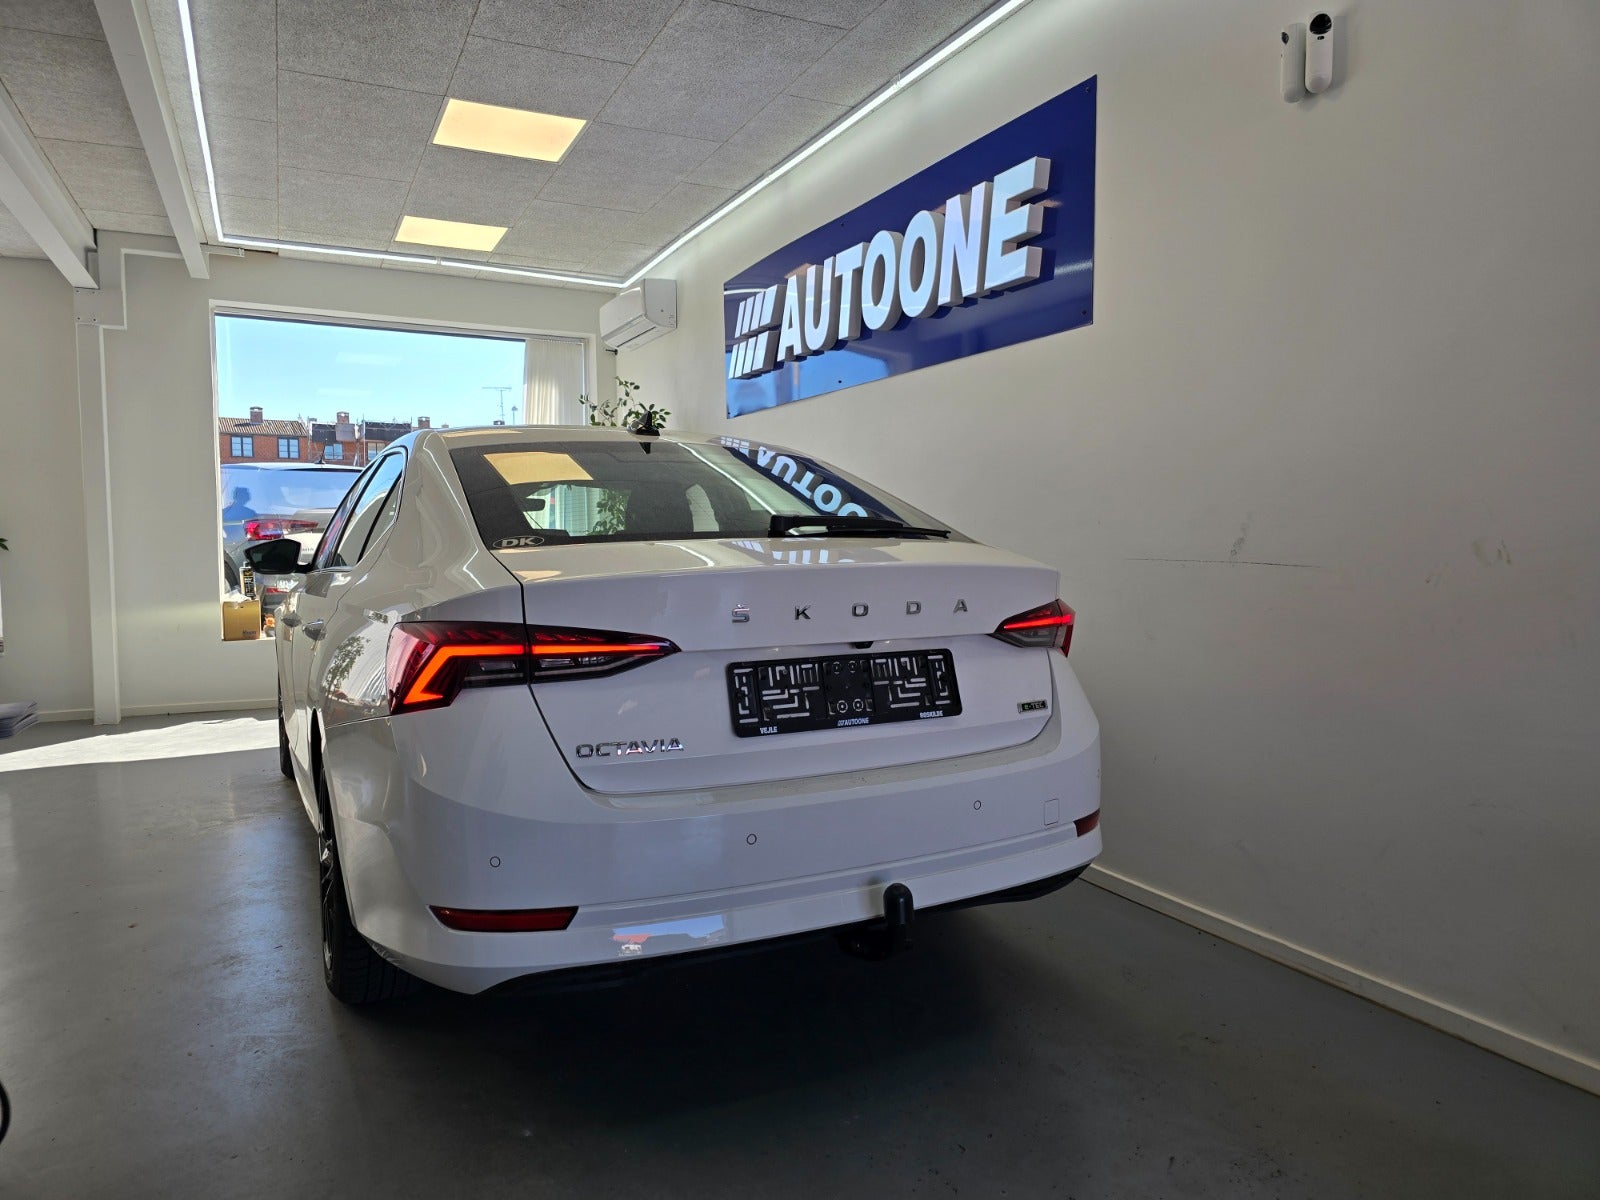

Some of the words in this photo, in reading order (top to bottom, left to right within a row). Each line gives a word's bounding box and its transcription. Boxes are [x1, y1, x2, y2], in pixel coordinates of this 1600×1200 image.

[776, 156, 1051, 362] AUTOONE
[501, 537, 536, 547] DK
[760, 726, 778, 735] VEJLE
[576, 738, 684, 758] OCTAVIA
